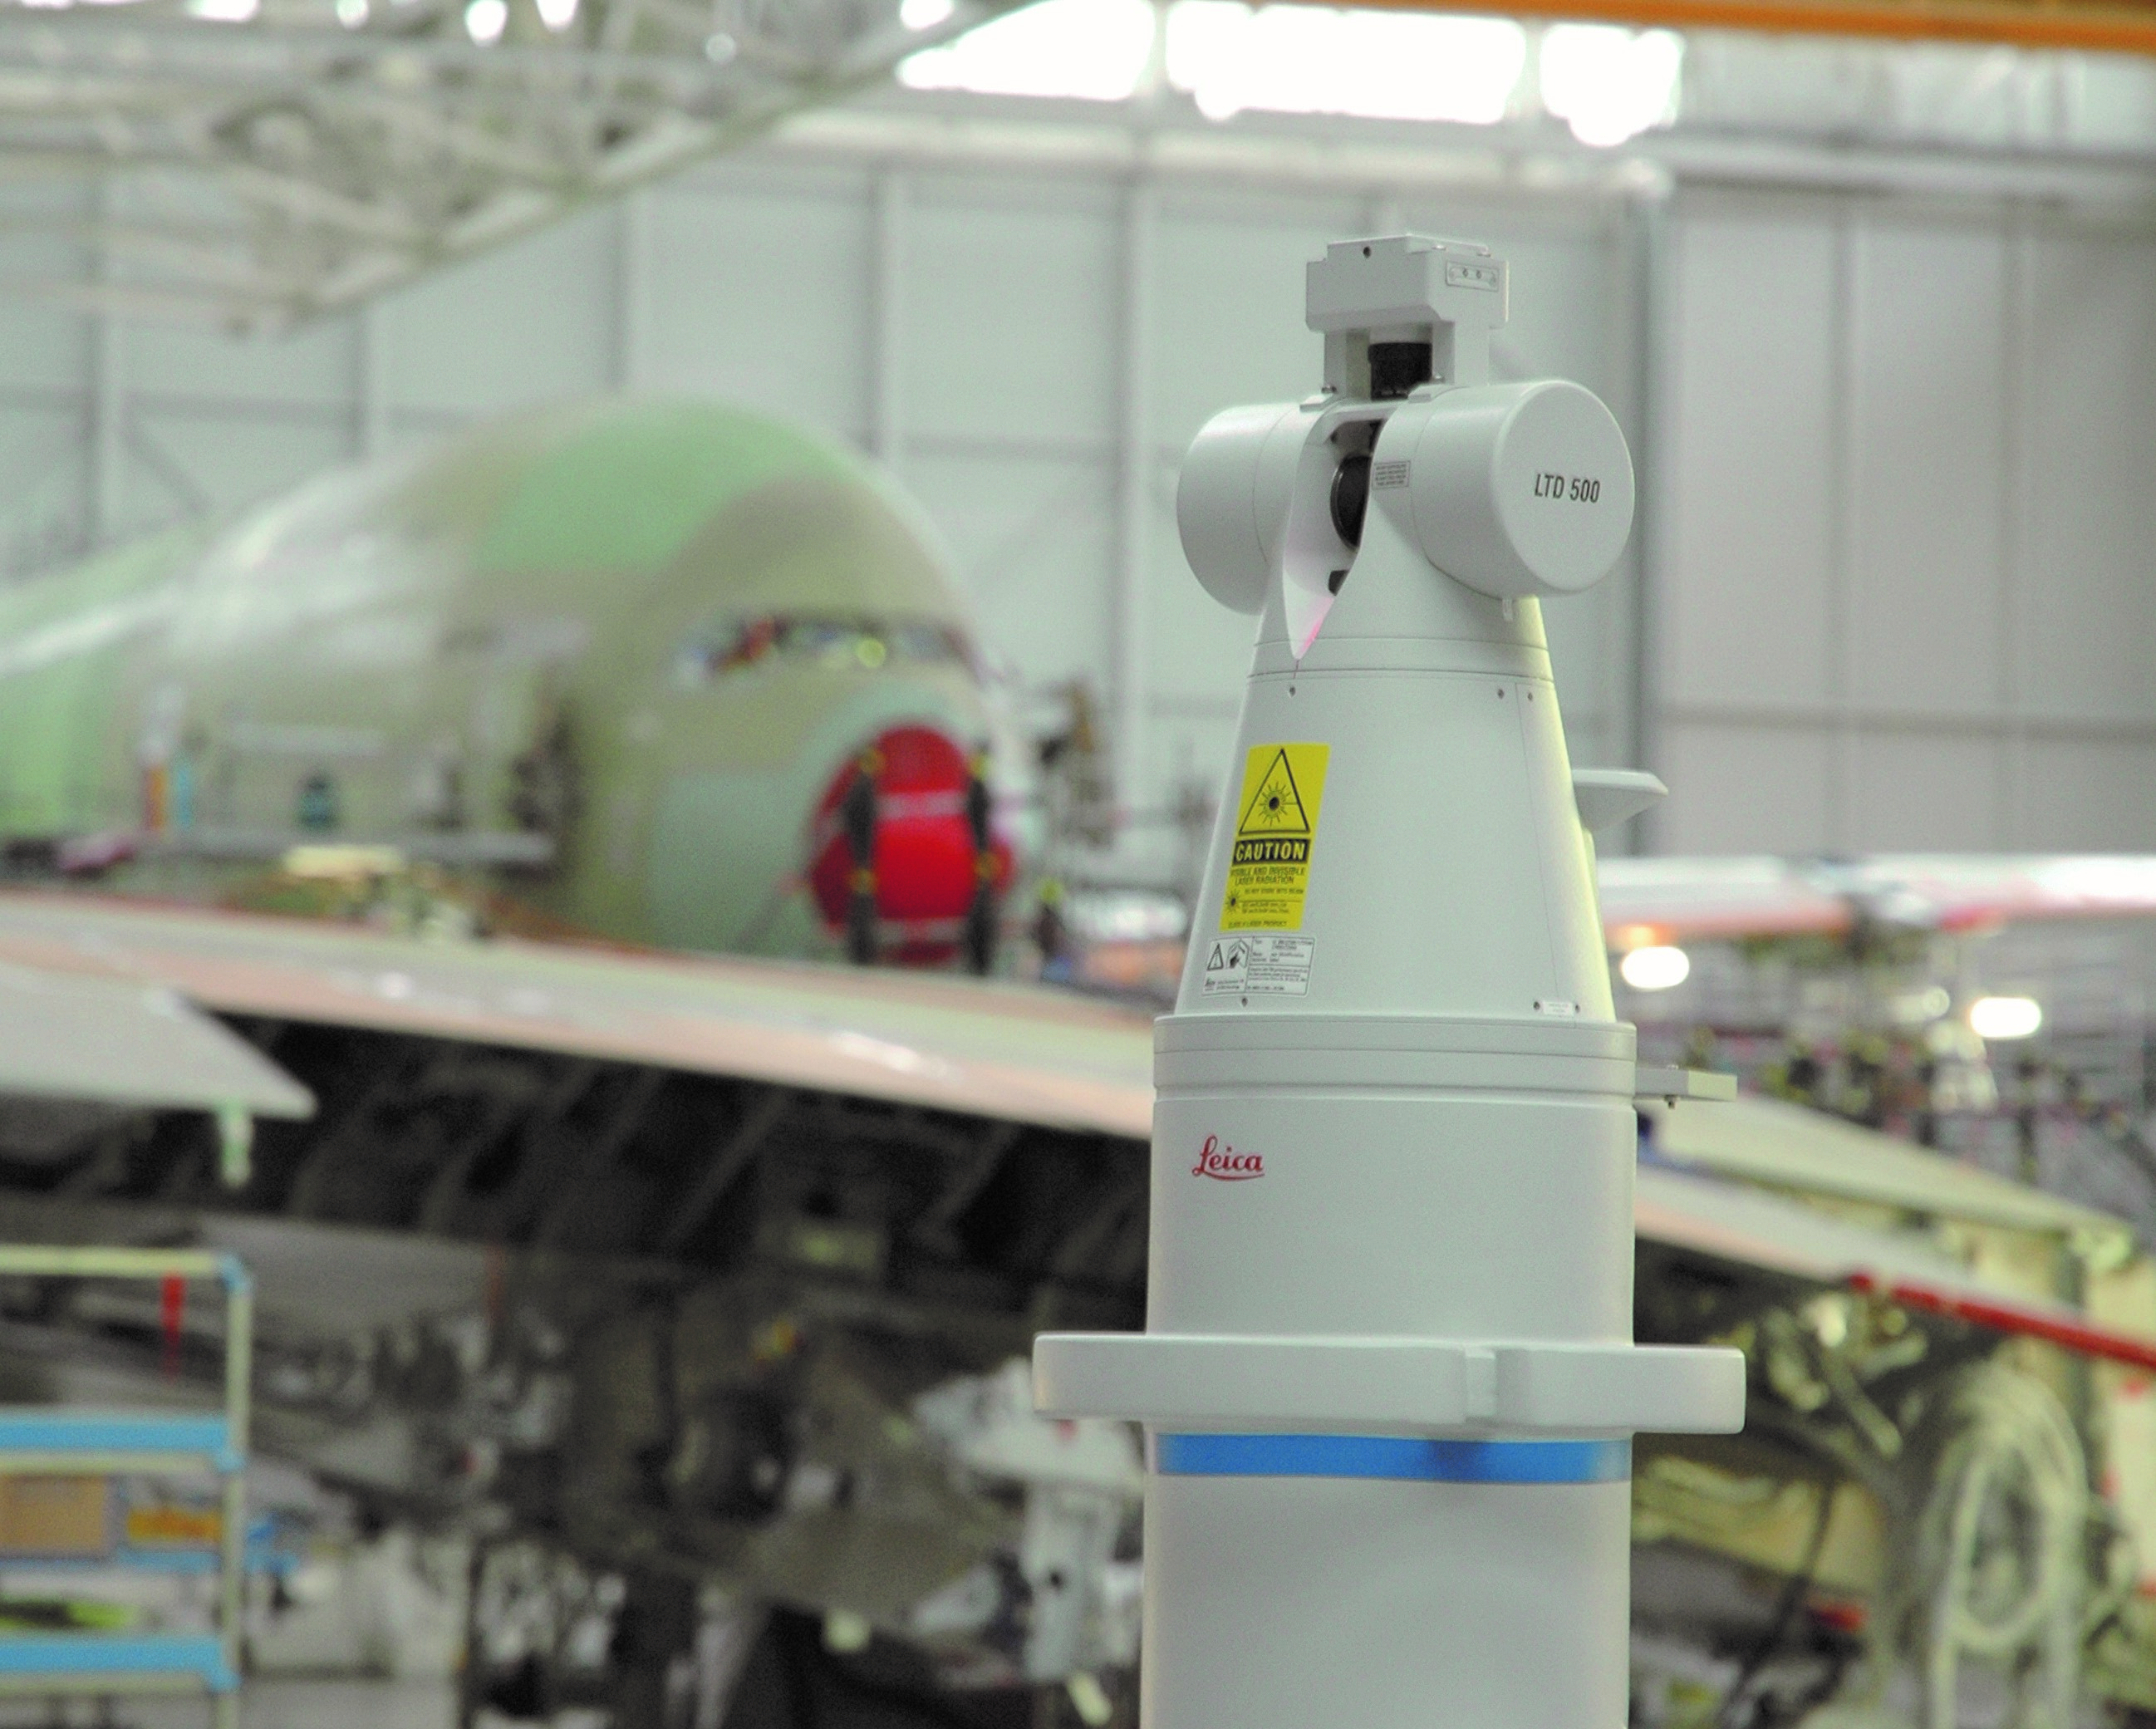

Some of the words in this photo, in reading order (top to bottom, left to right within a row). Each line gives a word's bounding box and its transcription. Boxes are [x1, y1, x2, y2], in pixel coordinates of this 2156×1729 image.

[1535, 474, 1564, 499] LTD
[1569, 479, 1600, 503] 500
[1235, 842, 1305, 862] CAUTION
[1191, 1135, 1265, 1180] Leica
